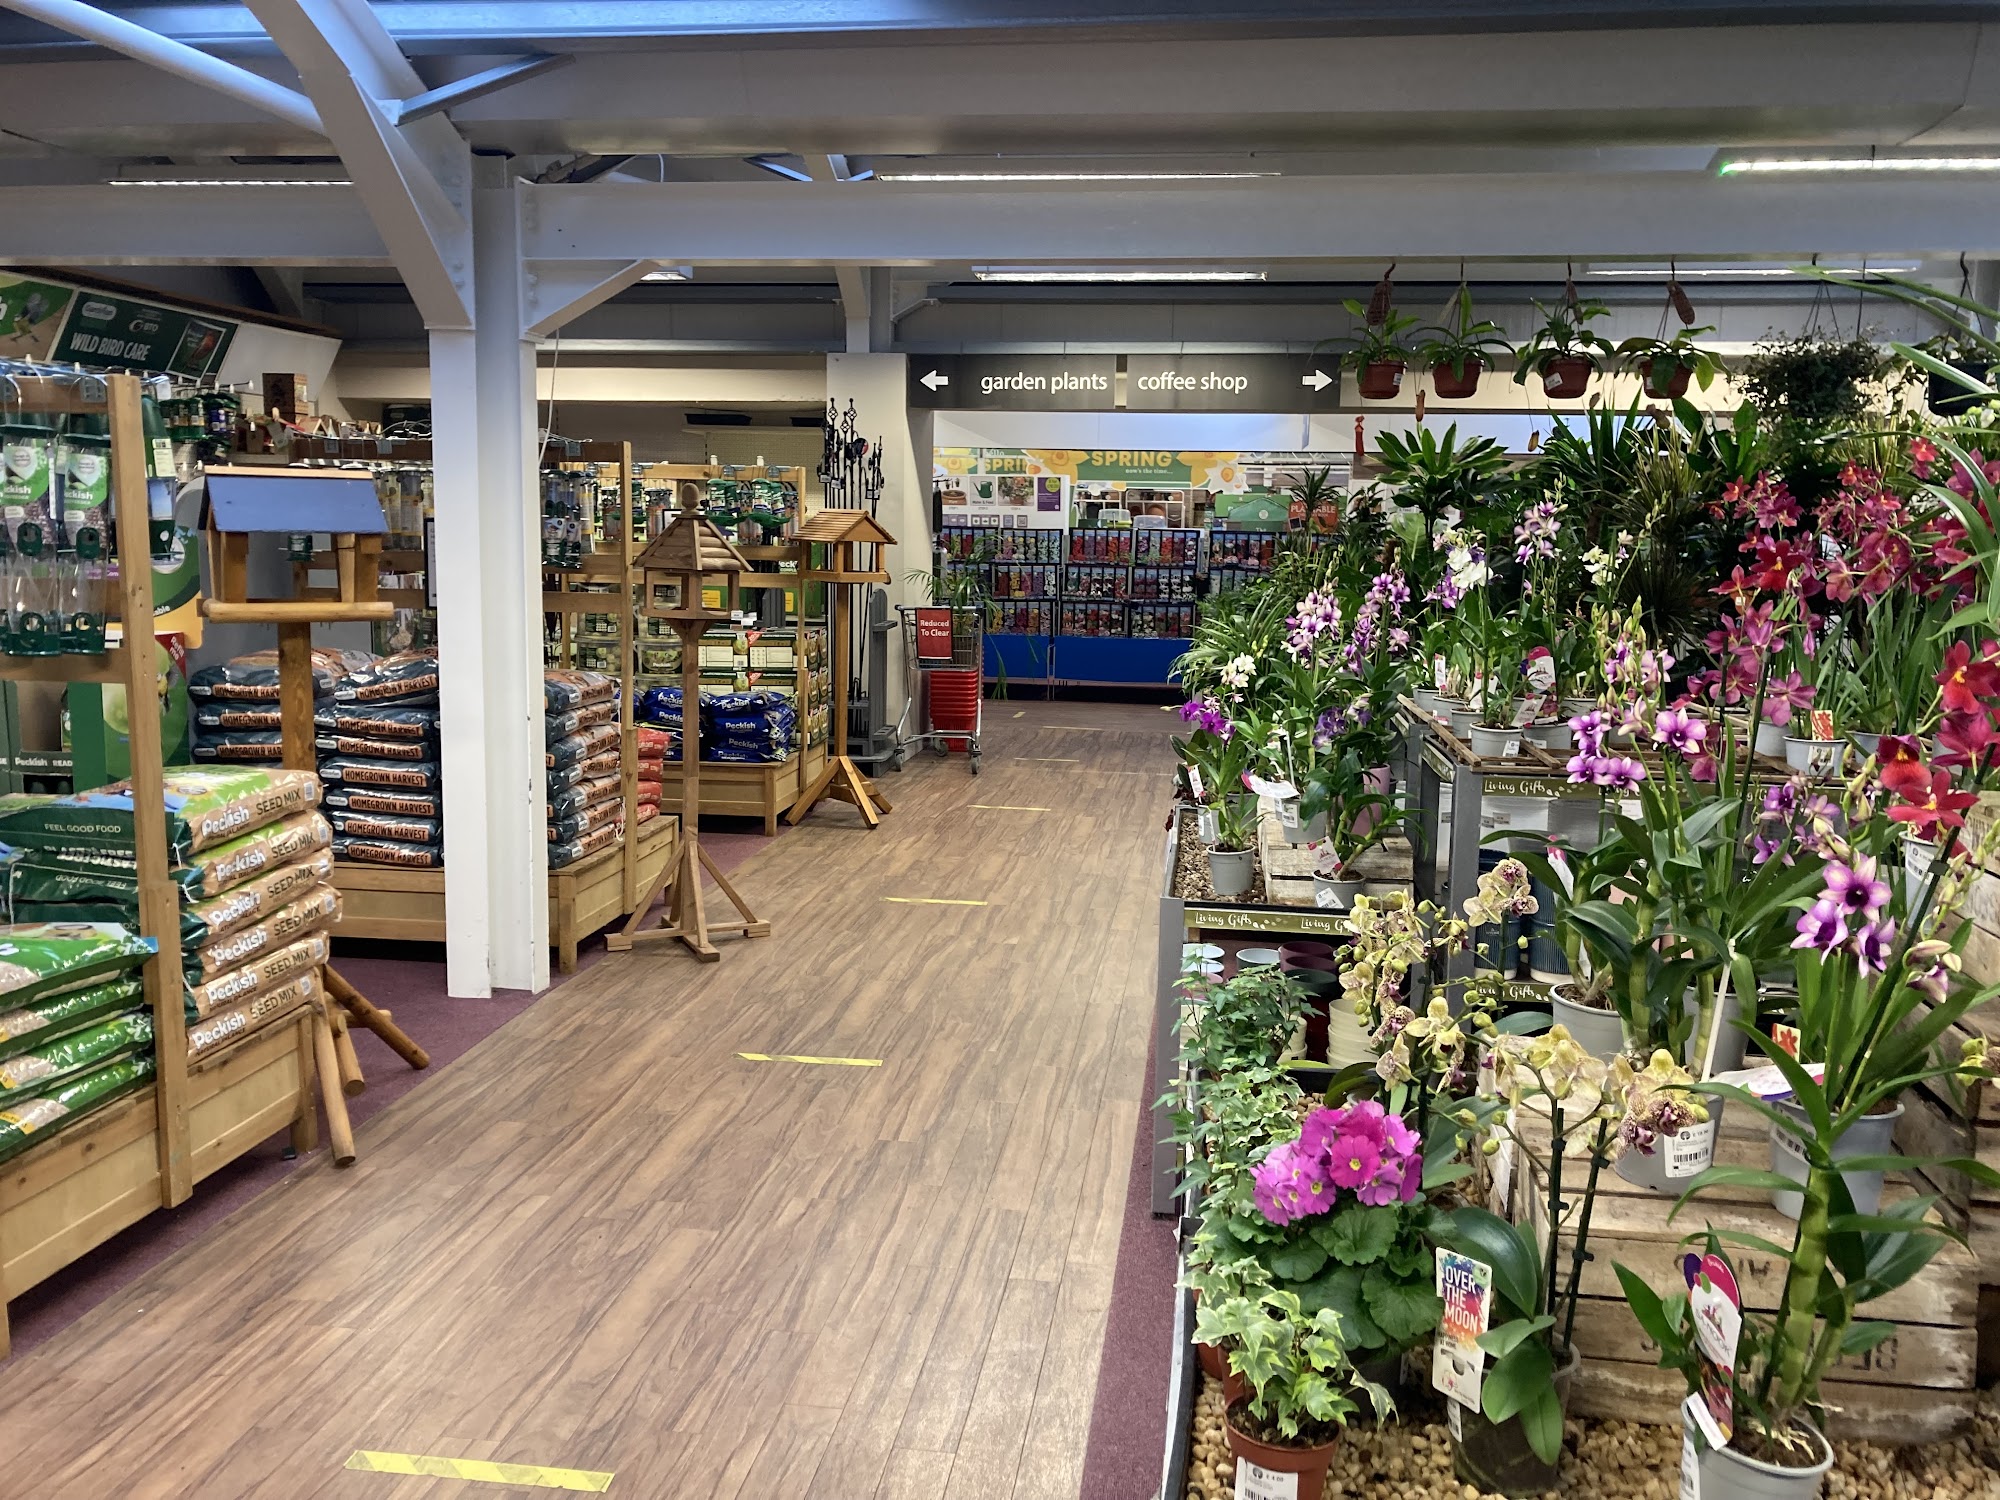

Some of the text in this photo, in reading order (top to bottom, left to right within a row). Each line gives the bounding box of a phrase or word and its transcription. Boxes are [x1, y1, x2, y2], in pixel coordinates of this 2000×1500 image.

[70, 332, 152, 361] WILD BIRD CARE
[981, 372, 1108, 394] garden plants
[1137, 371, 1248, 394] coffee shop
[1091, 451, 1172, 467] SPRING
[1290, 505, 1336, 513] PLAABLE
[921, 629, 949, 637] To Clear
[170, 646, 180, 661] me
[171, 636, 185, 658] Refill
[260, 687, 280, 698] HARV
[657, 692, 683, 704] Peckis
[658, 711, 683, 722] Peckis
[725, 721, 756, 730] Peckish
[219, 747, 265, 757] HOMEGROWN
[340, 741, 385, 755] HOMEGROWN
[728, 738, 758, 749] Peckish
[15, 757, 47, 766] Peckish
[345, 770, 390, 783] HOMEGROWN
[392, 774, 423, 786] HARVEST
[1485, 780, 1546, 796] Living Gifts
[256, 797, 283, 816] SEED
[283, 788, 301, 805] MIX
[351, 799, 397, 812] HOMEGROWN
[399, 802, 431, 814] HARVEST
[45, 823, 121, 834] FEEL GOOD FOOD
[202, 806, 250, 838] Peckish
[347, 822, 426, 840] HOMEGROWN HARVEST
[271, 833, 316, 859] SEED MIX
[216, 848, 266, 882] Peckish
[350, 847, 429, 865] HOMEGROWN HARVEST
[267, 866, 315, 898] SEED MIX
[208, 893, 261, 928] Peckish
[1195, 912, 1252, 927] Living Gifts
[274, 904, 321, 936] SEED MIX
[1301, 917, 1331, 930] Living
[214, 928, 268, 966] Peckish
[263, 947, 310, 979] SEED MIX
[206, 970, 258, 1005] Peckish
[1509, 985, 1535, 1000] Gifts
[250, 985, 298, 1019] SEED MIX
[192, 1011, 247, 1049] Peckish
[1445, 1265, 1476, 1294] OVER
[1445, 1283, 1467, 1309] THE
[1445, 1302, 1479, 1334] MOON
